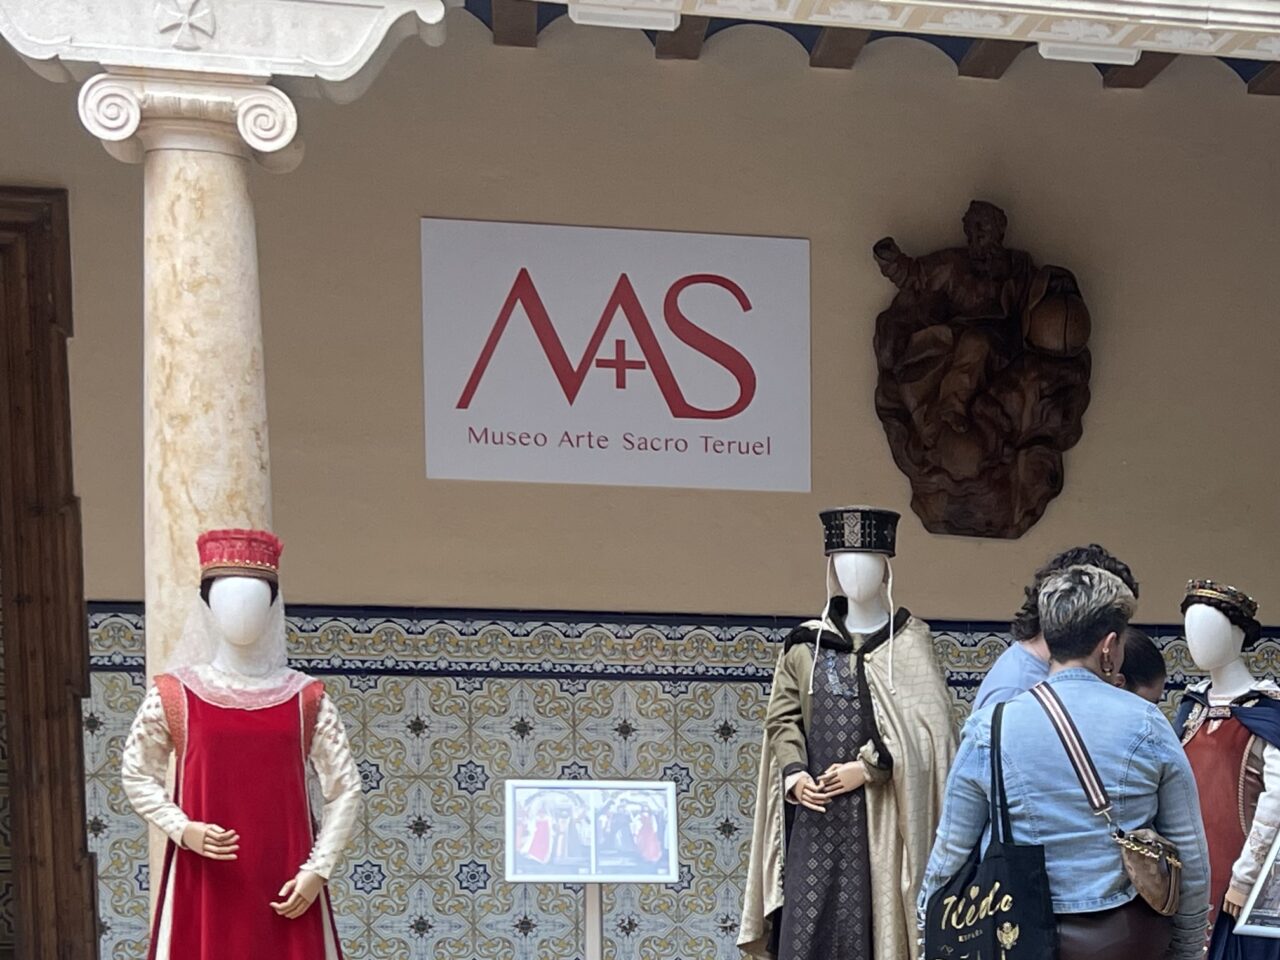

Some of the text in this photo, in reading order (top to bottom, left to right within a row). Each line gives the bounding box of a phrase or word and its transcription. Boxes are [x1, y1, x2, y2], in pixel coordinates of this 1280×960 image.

[468, 426, 772, 456] Museo Arte Sacro Teruel
